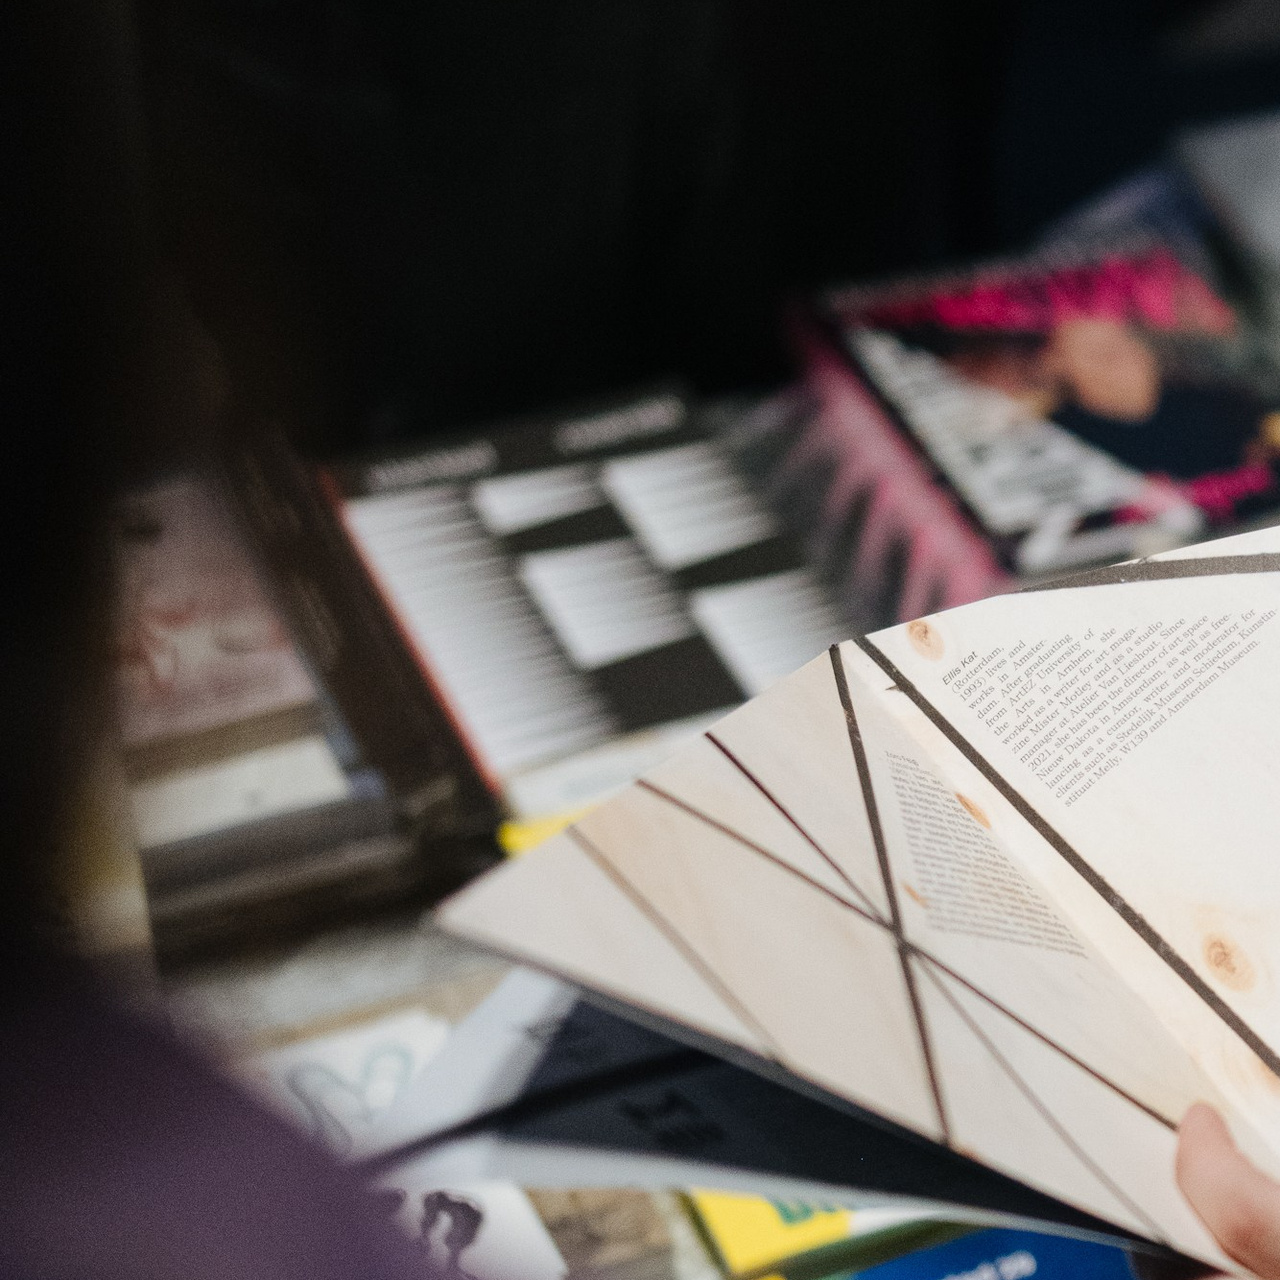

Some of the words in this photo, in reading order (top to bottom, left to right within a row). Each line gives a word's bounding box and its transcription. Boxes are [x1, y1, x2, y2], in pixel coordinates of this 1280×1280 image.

[940, 665, 962, 686] Ellis
[959, 649, 979, 669] Kat
[950, 646, 1005, 694] (Rotterdam,
[956, 675, 987, 702] 1993)
[983, 657, 1008, 678] lives
[1007, 638, 1027, 659] and
[967, 684, 995, 710] works
[995, 672, 1010, 684] in
[1011, 638, 1047, 672] Amster-
[976, 698, 1000, 720] dam.
[999, 674, 1023, 699] After
[1022, 632, 1074, 679] graduating
[983, 706, 1008, 728] from
[1008, 677, 1037, 708] ArtEZ
[1034, 639, 1081, 680] University
[1082, 627, 1095, 641] of
[992, 720, 1010, 737] the
[1014, 697, 1036, 719] Arts
[1038, 683, 1052, 695] in
[1055, 647, 1095, 681] Arnhem,
[1098, 626, 1117, 643] she
[1000, 713, 1034, 745] worked
[1032, 704, 1046, 718] as
[1045, 697, 1055, 707] a
[1052, 673, 1080, 698] writer
[1077, 661, 1094, 677] for
[1093, 648, 1110, 665] art
[1108, 626, 1137, 652] maga-
[1010, 734, 1031, 755] zine
[1028, 707, 1060, 737] Mister
[1058, 679, 1092, 710] Motley
[1092, 661, 1112, 682] and
[1111, 652, 1125, 666] as
[1124, 645, 1134, 655] a
[1133, 620, 1163, 647] studio
[1018, 725, 1058, 764] manager
[1057, 716, 1070, 729] at
[1068, 689, 1100, 719] Atelier
[1097, 673, 1120, 690] Van
[1115, 639, 1161, 676] Lieshout.
[1158, 617, 1186, 640] Since
[1026, 747, 1056, 772] 2021,
[1053, 732, 1071, 749] she
[1066, 717, 1088, 735] has
[1083, 698, 1110, 720] been
[1106, 685, 1124, 701] the
[1122, 655, 1158, 688] director
[1157, 644, 1169, 659] of
[1166, 635, 1184, 651] art
[1181, 614, 1209, 639] space
[1034, 753, 1065, 781] Nieuw
[1062, 723, 1100, 756] Dakota
[1097, 713, 1111, 725] in
[1110, 668, 1167, 716] Amsterdam,
[1165, 655, 1179, 669] as
[1177, 637, 1199, 657] well
[1197, 628, 1212, 642] as
[1209, 612, 1232, 631] free-
[1043, 757, 1082, 790] lancing
[1080, 744, 1095, 758] as
[1095, 736, 1105, 745] a
[1105, 704, 1142, 736] curator,
[1142, 678, 1170, 703] writer
[1171, 659, 1191, 680] and
[1192, 620, 1239, 663] moderator
[1239, 607, 1256, 623] for
[1054, 770, 1085, 799] clients
[1083, 751, 1107, 773] such
[1104, 740, 1118, 754] as
[1114, 707, 1157, 745] Stedelijk
[1152, 675, 1195, 711] Museum
[1191, 639, 1241, 678] Schiedam,
[1236, 608, 1278, 641] Kunstin-
[1063, 777, 1096, 808] stituut
[1091, 754, 1123, 780] Melly,
[1118, 728, 1149, 754] W139
[1147, 712, 1168, 733] and
[1166, 671, 1220, 718] Amsterdam
[1215, 639, 1261, 674] Museum.
